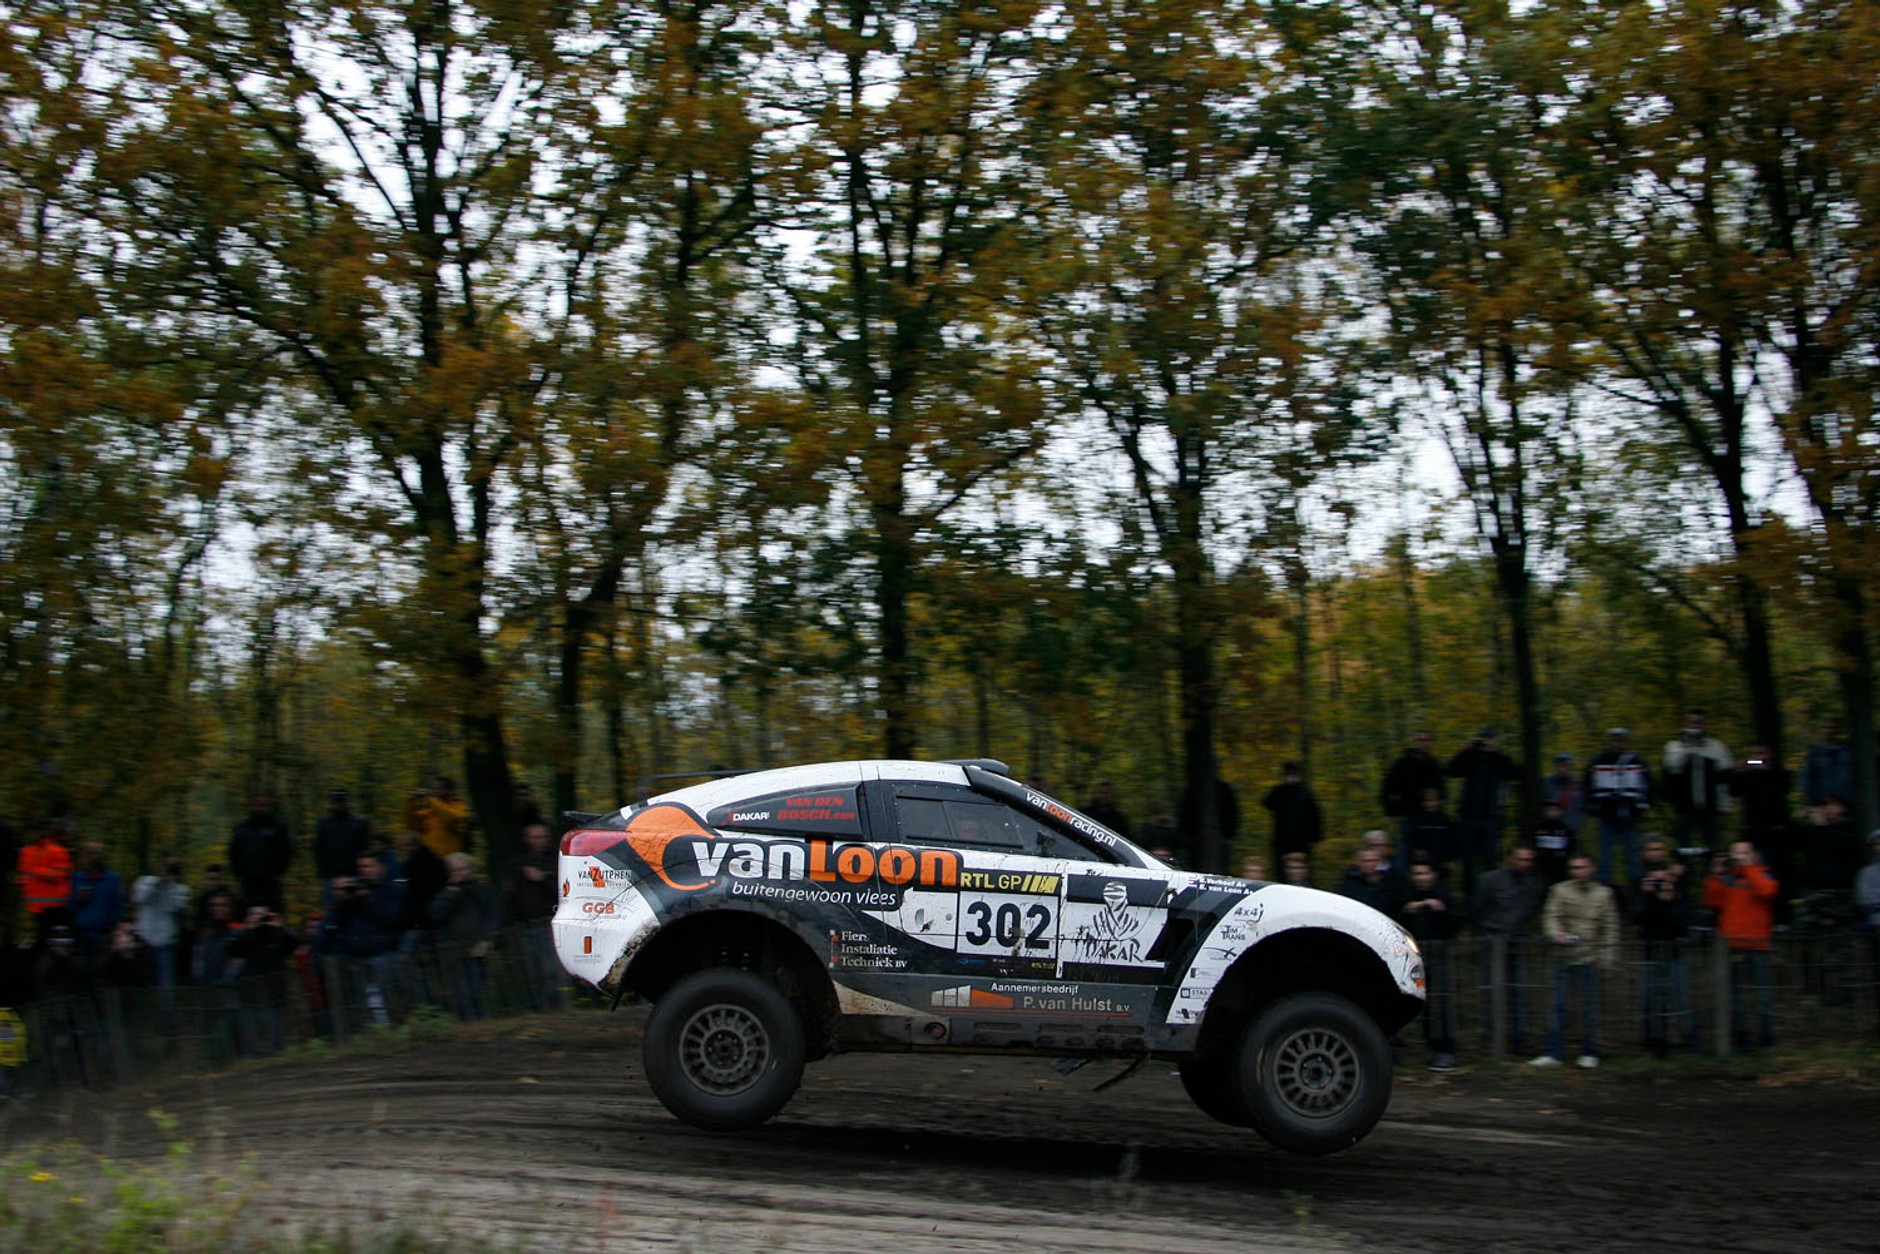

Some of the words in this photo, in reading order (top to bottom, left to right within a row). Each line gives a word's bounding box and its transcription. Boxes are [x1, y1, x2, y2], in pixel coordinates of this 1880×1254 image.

[733, 812, 768, 821] DAKAR
[960, 872, 995, 889] RTL
[998, 875, 1022, 889] GP
[732, 881, 851, 904] buitengewoon
[855, 887, 896, 905] vlees
[965, 901, 1051, 950] 302
[842, 957, 893, 968] Techniek
[991, 982, 1079, 996] Aannemersbedrijf
[1039, 1000, 1066, 1010] van
[1071, 997, 1112, 1011] Hulst
